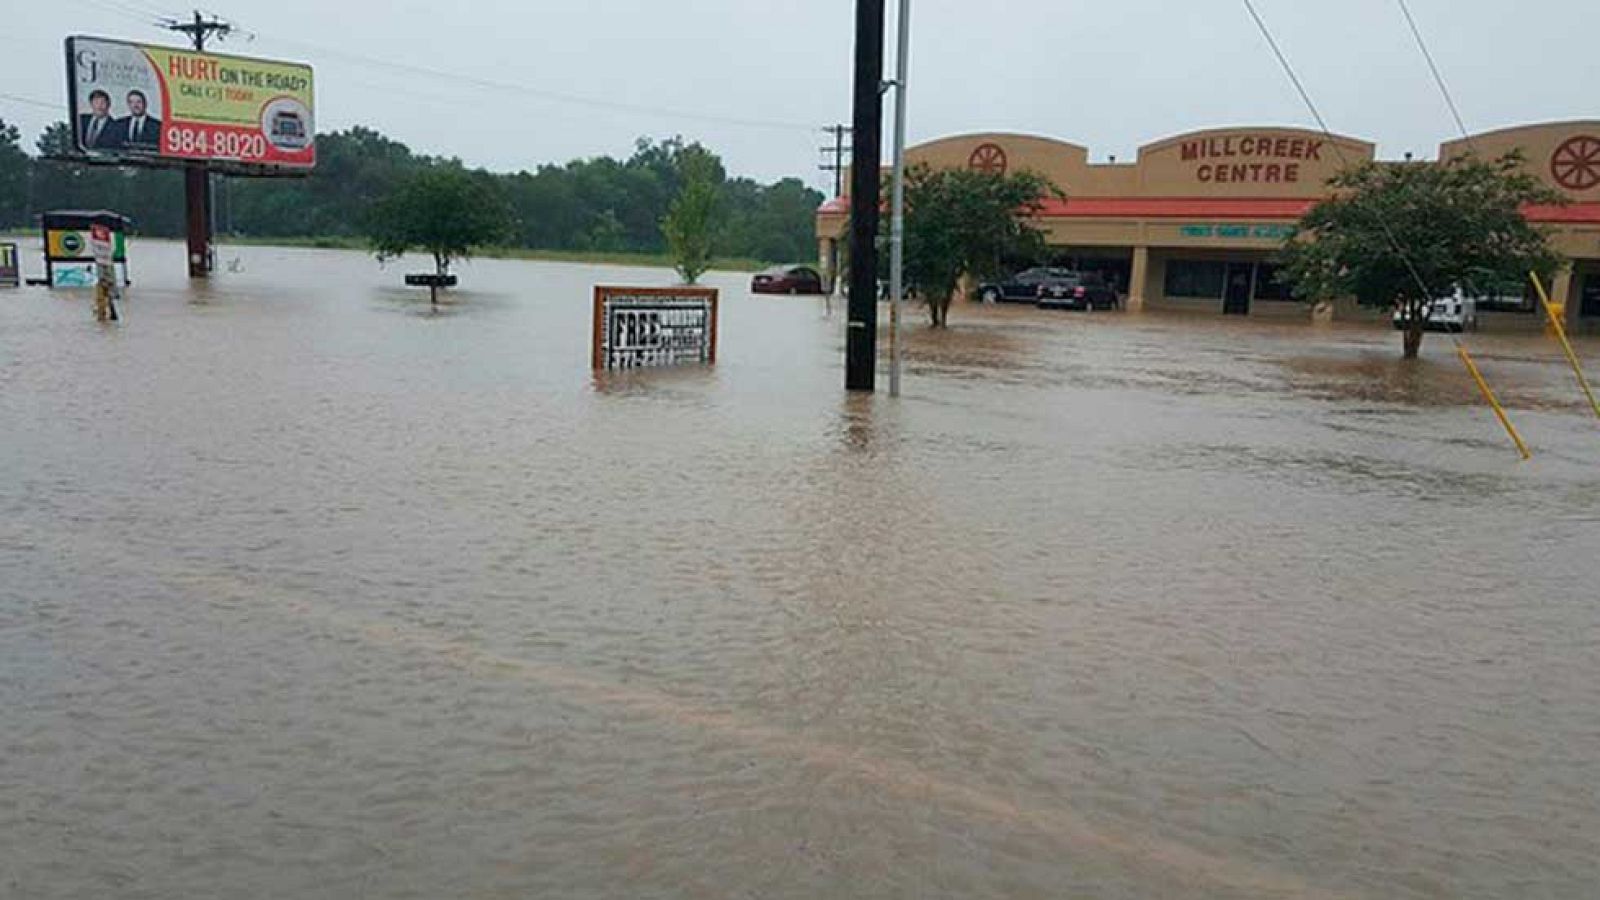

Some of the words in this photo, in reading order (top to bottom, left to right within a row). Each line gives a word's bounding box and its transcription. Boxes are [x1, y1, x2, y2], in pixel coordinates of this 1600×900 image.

[169, 55, 218, 81] HURT
[220, 67, 239, 83] ON
[242, 70, 264, 87] THE
[266, 73, 307, 90] ROAD?
[181, 84, 204, 97] CALL
[1180, 137, 1323, 161] MILLCREEK
[1197, 163, 1300, 183] CENTRE
[615, 312, 659, 348] FREE
